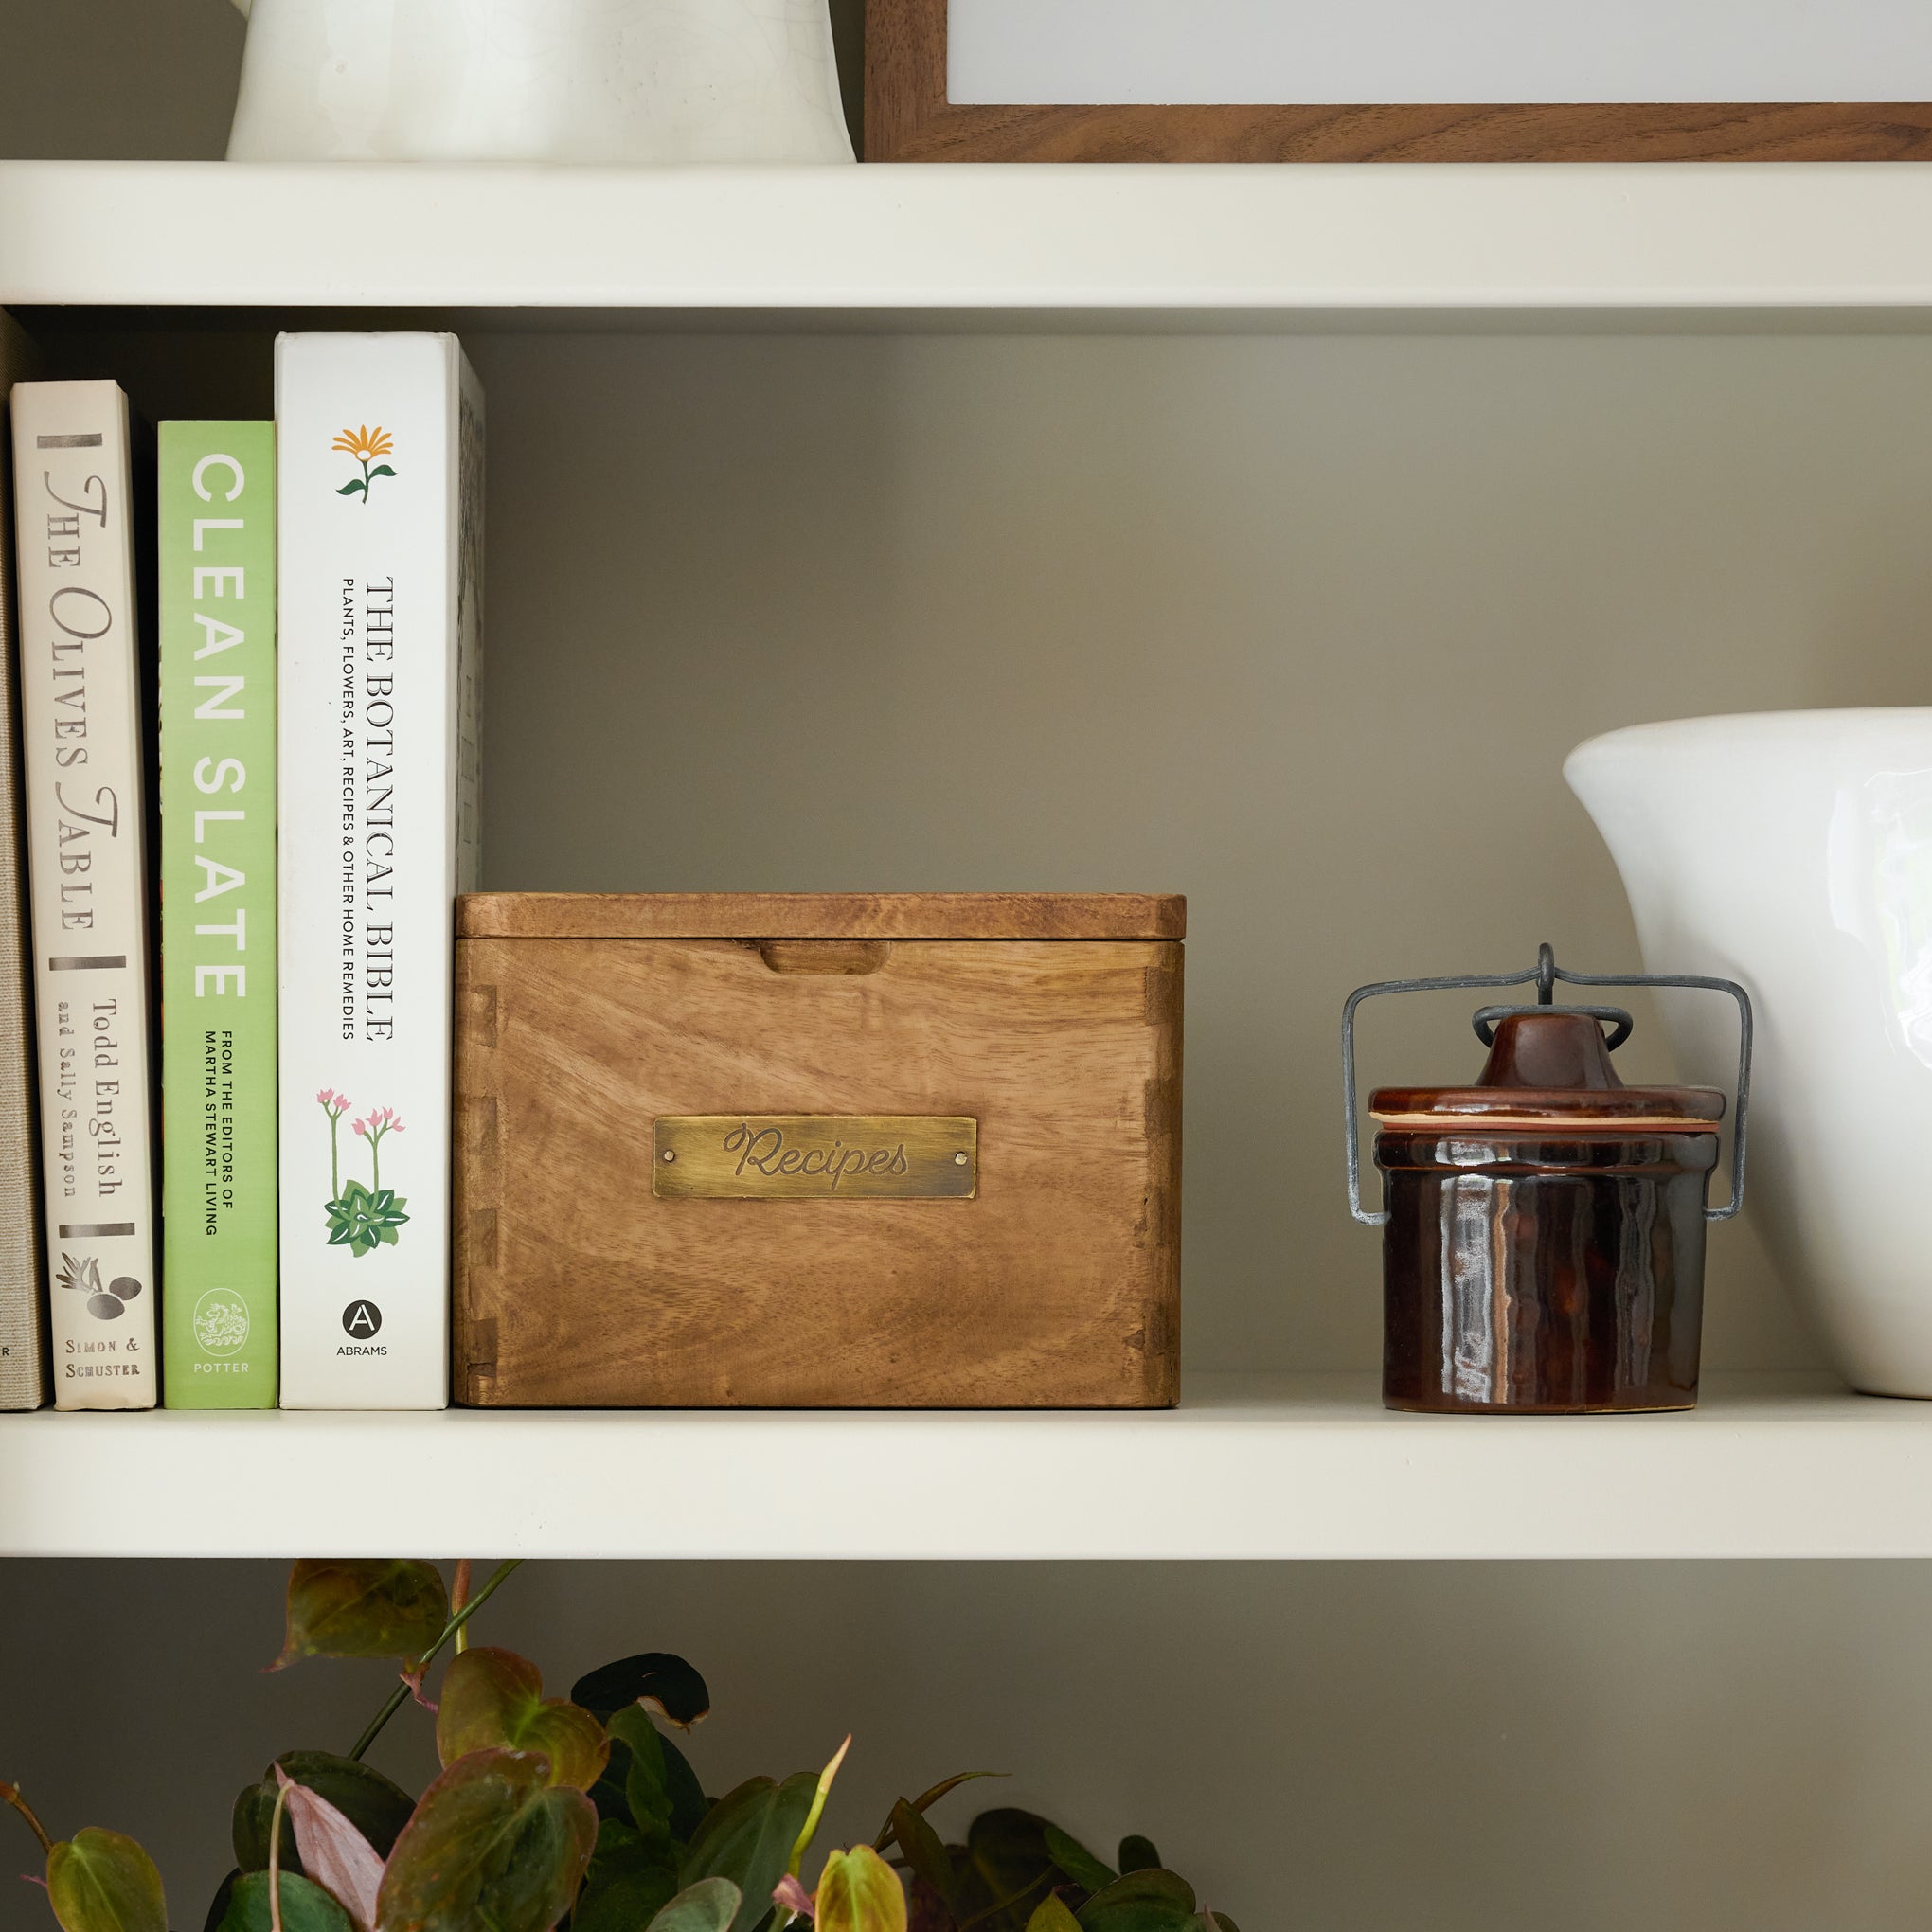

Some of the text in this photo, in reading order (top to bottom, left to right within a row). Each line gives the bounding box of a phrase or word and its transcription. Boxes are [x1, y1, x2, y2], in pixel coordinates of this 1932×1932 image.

[44, 471, 118, 929] THE OLIVES TABLE
[192, 453, 245, 996] CLEAN SLATE
[340, 579, 354, 1039] PLANTS, FLOWERS, ART, RECIPES & OTHER HOME REMEDIES
[366, 577, 393, 1041] THE BOTANICAL BIBLE
[57, 1002, 77, 1197] and Sally Sampson
[89, 999, 122, 1197] Todd English
[206, 1031, 217, 1235] MARTHA STEWART LIVING
[222, 1031, 233, 1208] FROM THE EDITORS OF
[723, 1122, 908, 1190] Recipes
[65, 1338, 140, 1353] SIMON &
[66, 1364, 140, 1378] SCHUSTER
[195, 1363, 248, 1372] POTTER
[337, 1347, 387, 1355] ABRAMS
